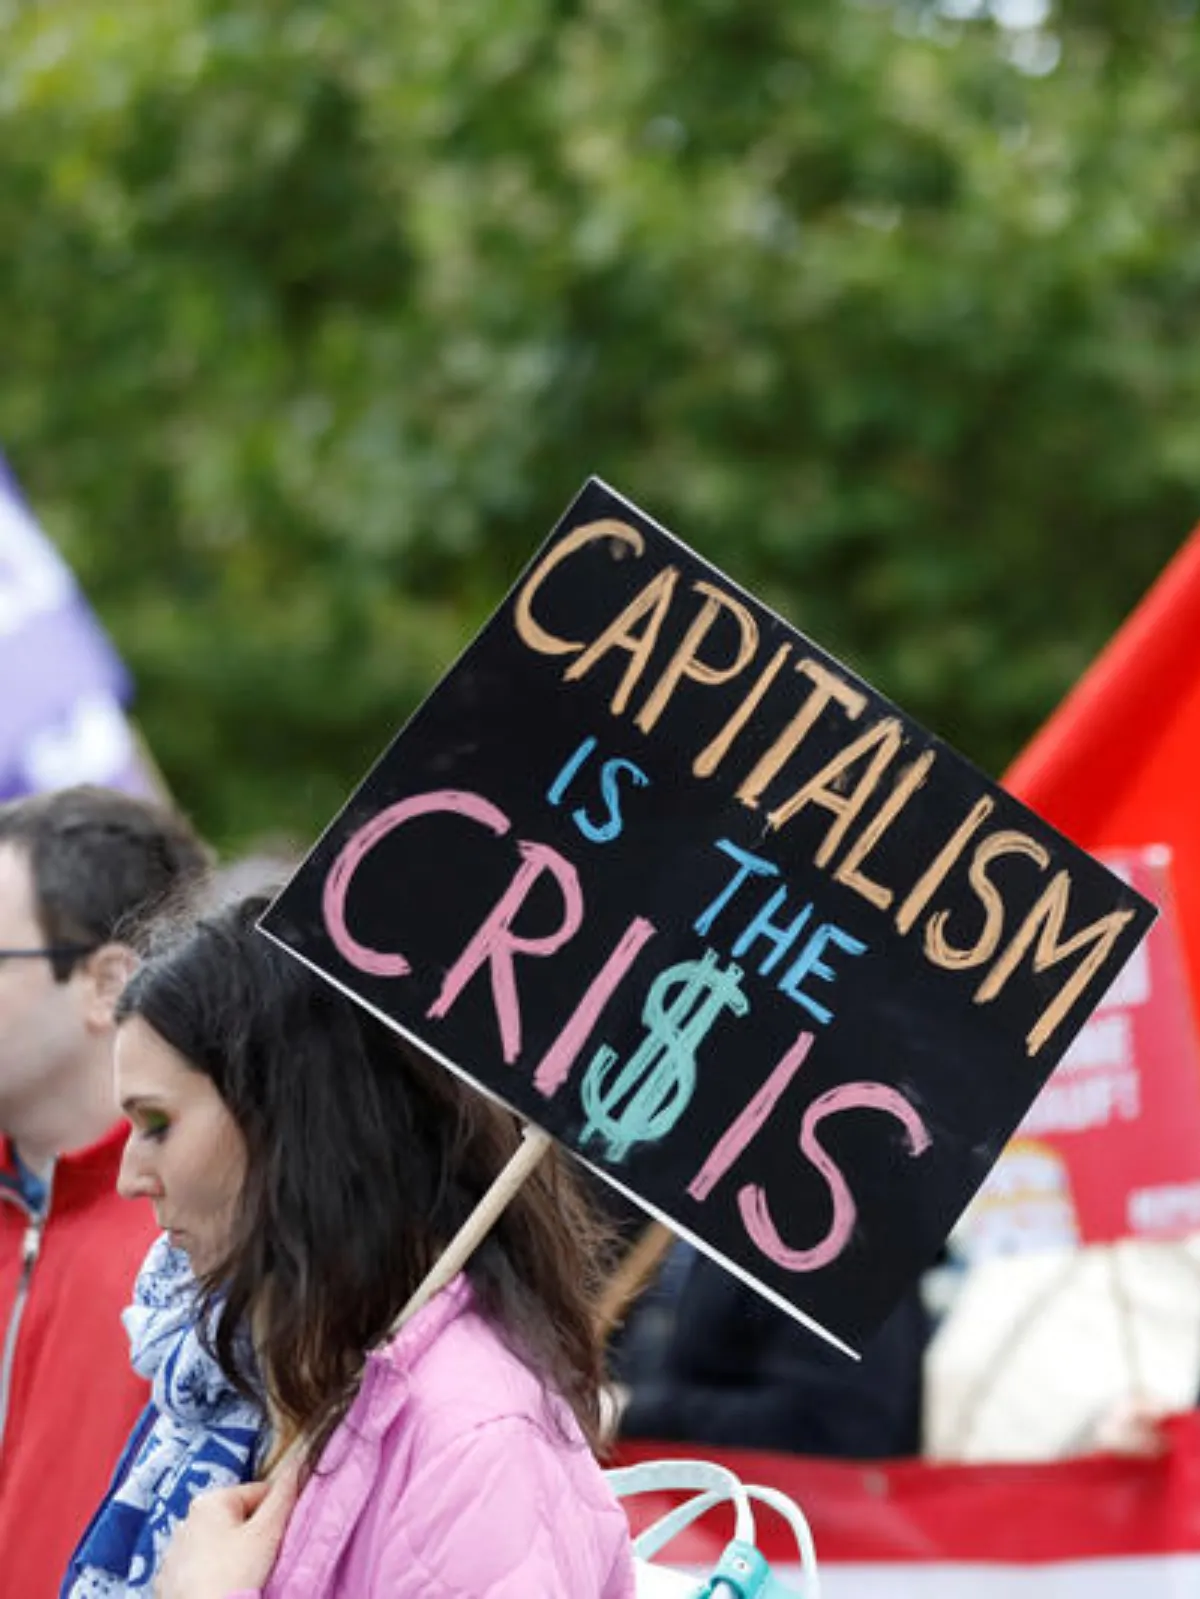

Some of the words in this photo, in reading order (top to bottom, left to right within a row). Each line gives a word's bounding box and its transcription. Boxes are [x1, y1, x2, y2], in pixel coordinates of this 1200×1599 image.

[515, 519, 1135, 1056] CAPITALISM
[547, 737, 649, 843] IS
[693, 838, 868, 1025] THE
[322, 789, 934, 1272] CRI$IS
